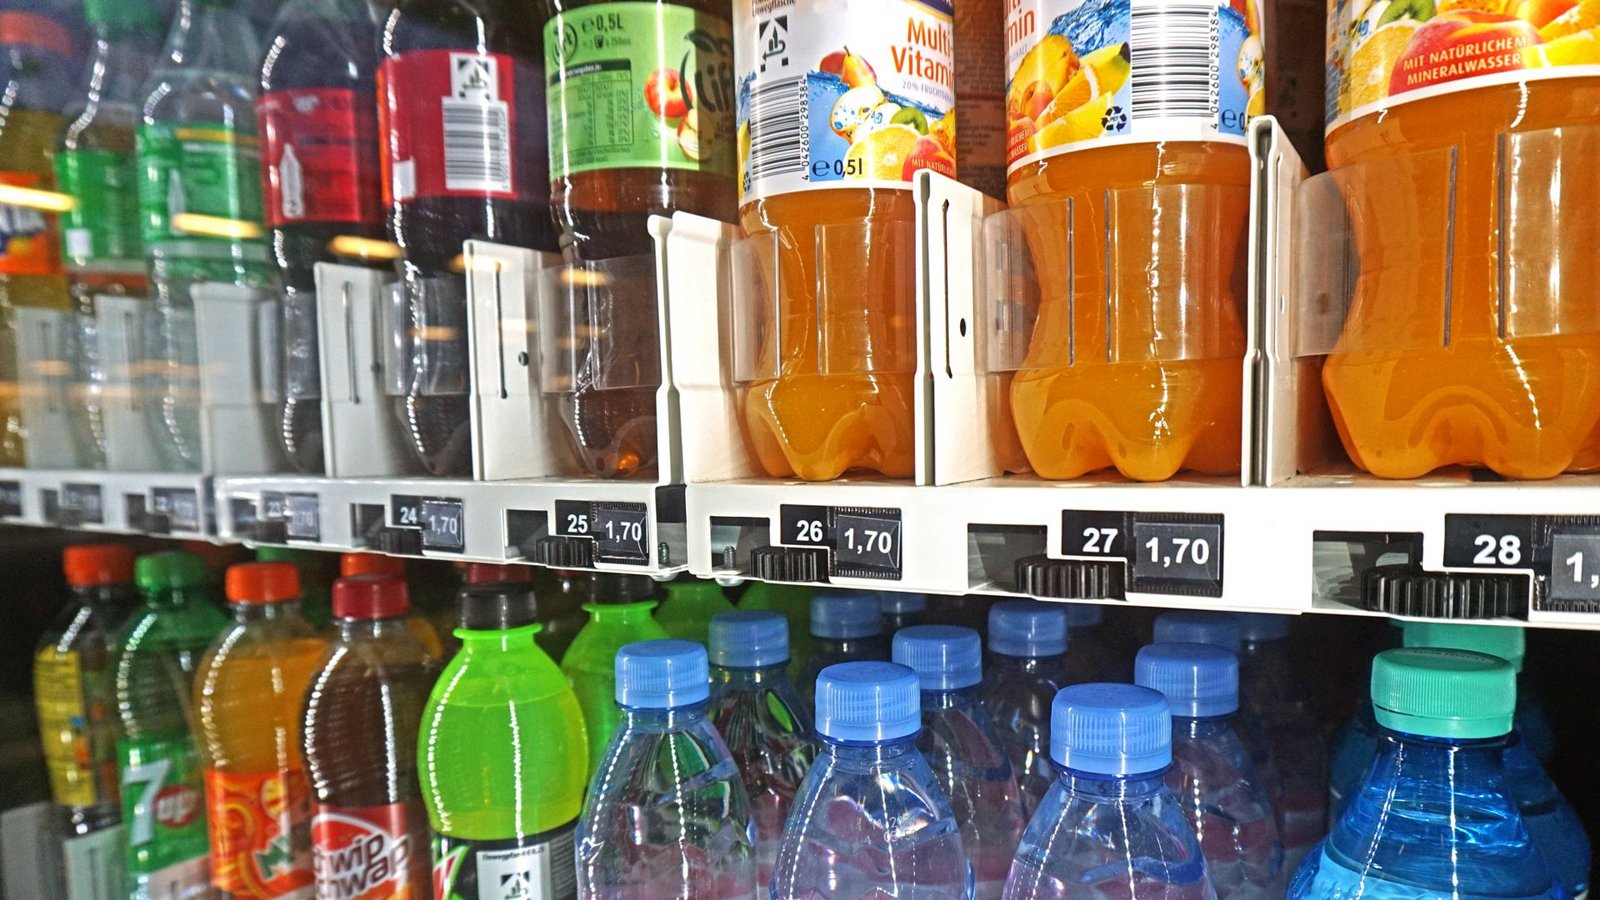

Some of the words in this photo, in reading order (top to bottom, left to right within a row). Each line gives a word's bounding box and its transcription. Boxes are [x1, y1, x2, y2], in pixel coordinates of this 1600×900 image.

[1403, 55, 1424, 71] MIT
[1429, 36, 1528, 64] NATÜRLICHEM
[1407, 53, 1521, 85] MINERALWASSER
[400, 507, 417, 524] 24
[429, 514, 458, 535] 1,70
[567, 514, 588, 534] 25
[605, 520, 642, 544] 1,70
[796, 519, 823, 543] 26
[844, 527, 892, 555] 1,70
[1082, 527, 1119, 554] 27
[1145, 537, 1210, 568] 1,70
[1473, 534, 1521, 565] 28
